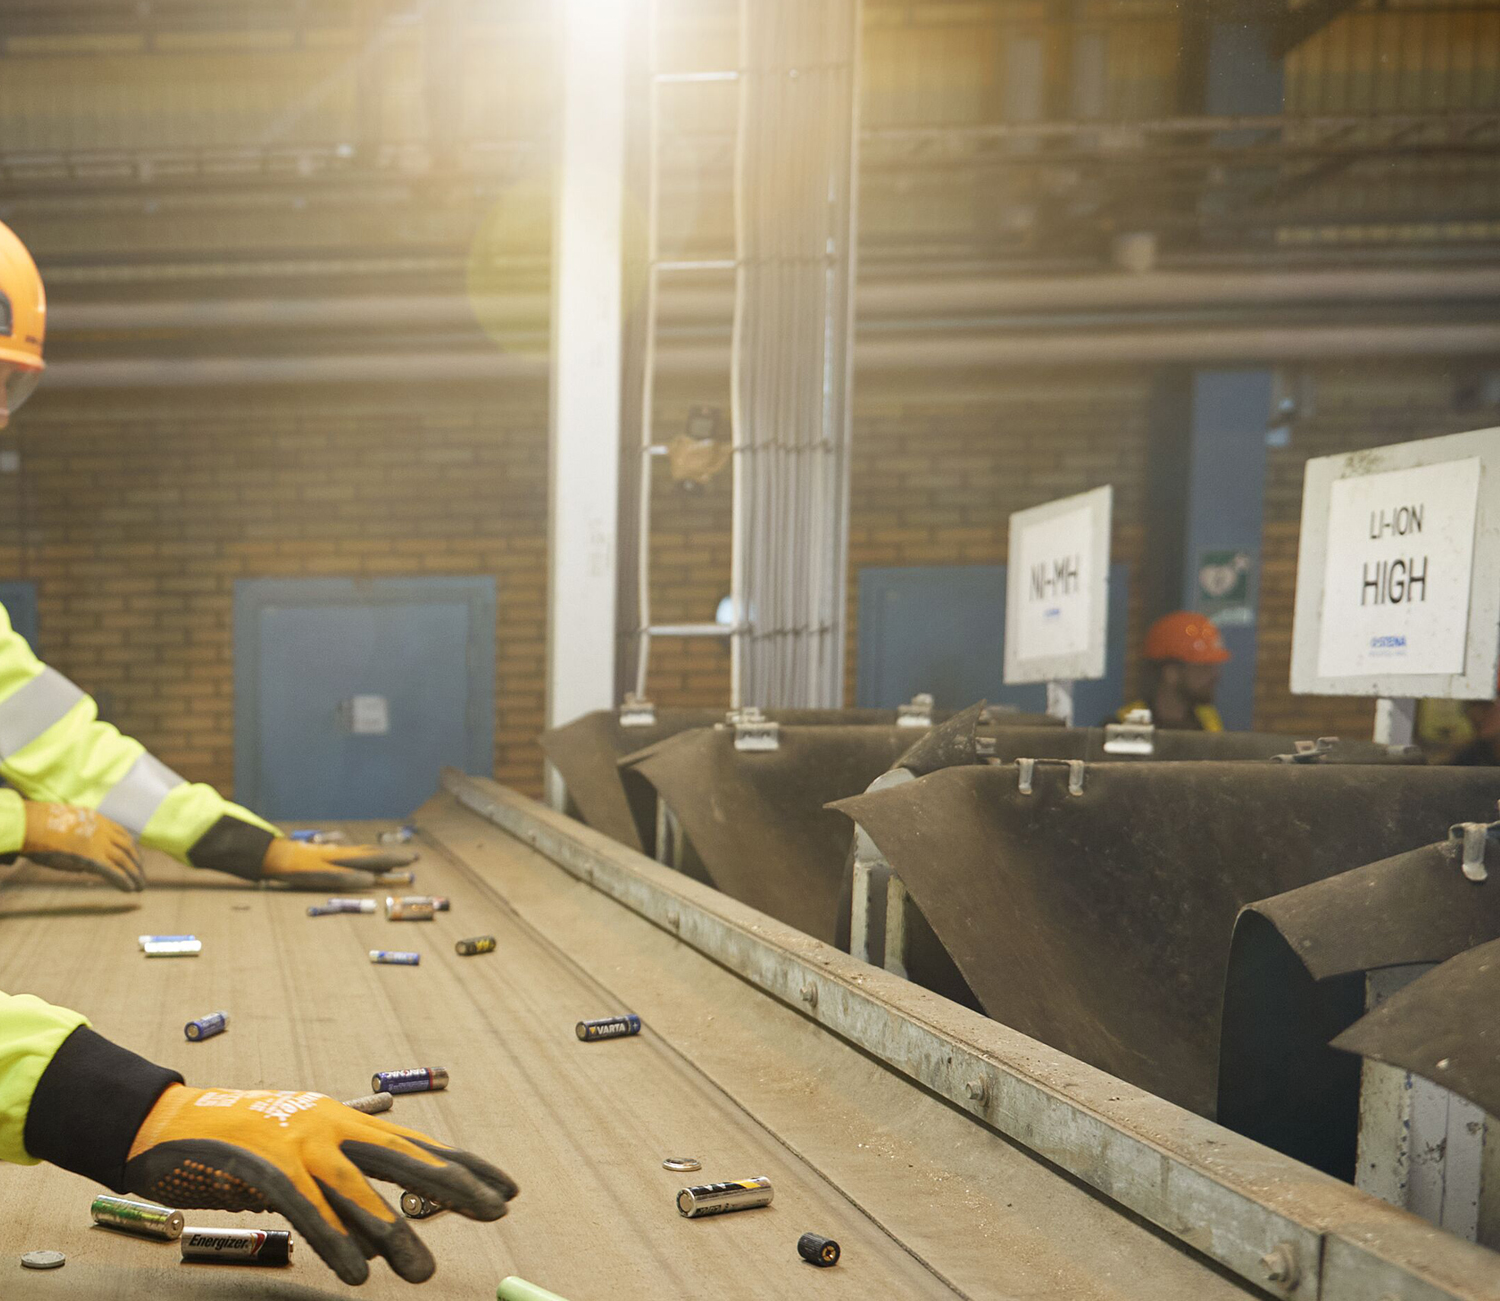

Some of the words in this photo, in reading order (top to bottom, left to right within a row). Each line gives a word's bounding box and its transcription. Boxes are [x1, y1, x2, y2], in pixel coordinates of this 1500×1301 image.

[1369, 503, 1424, 539] LI-ION
[1029, 552, 1080, 601] NI-MH
[1361, 555, 1428, 606] HIGH
[597, 1022, 626, 1034] VARTA
[189, 1234, 246, 1251] Energizer
